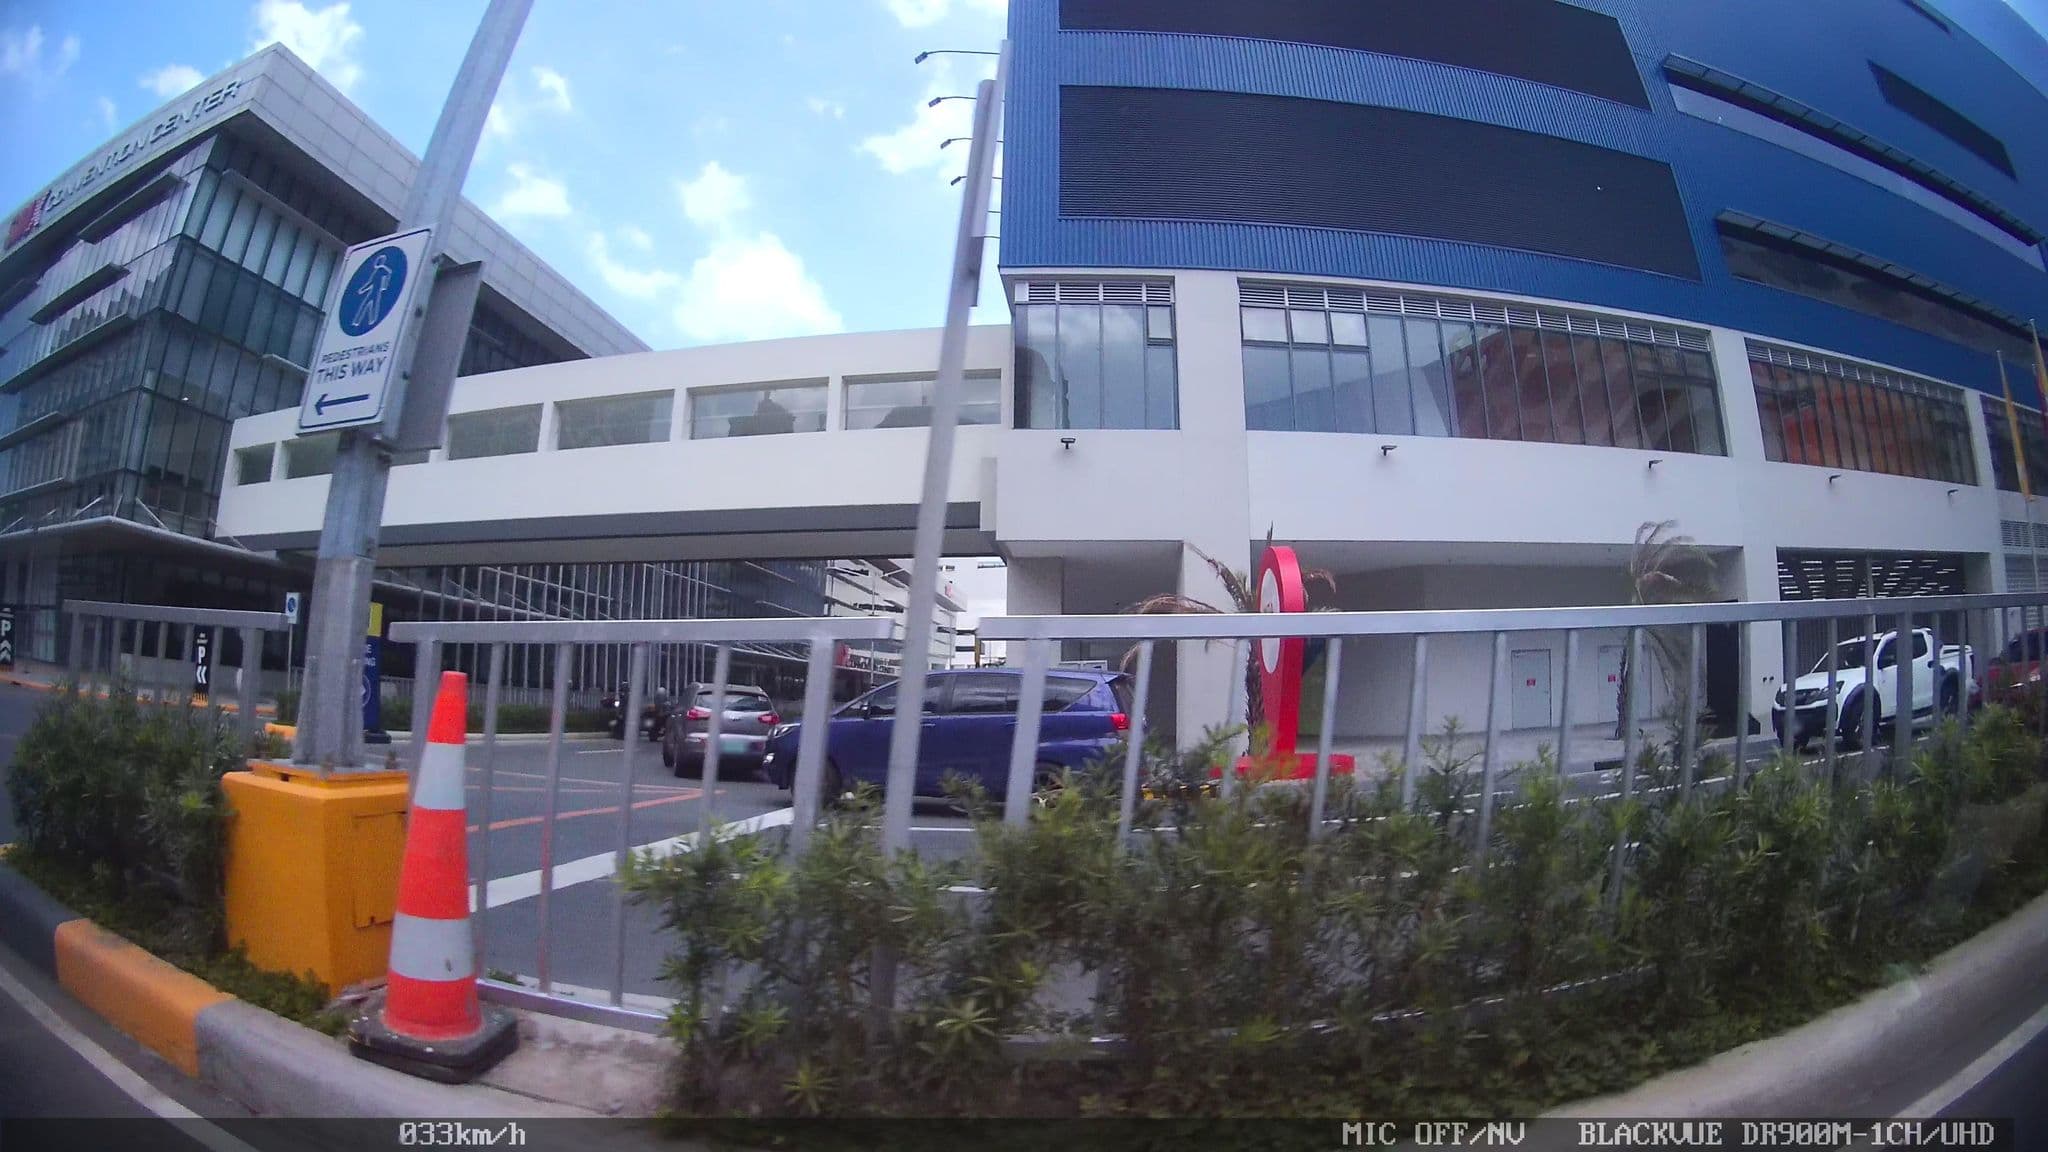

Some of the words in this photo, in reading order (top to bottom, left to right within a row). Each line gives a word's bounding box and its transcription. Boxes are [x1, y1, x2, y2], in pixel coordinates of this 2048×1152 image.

[46, 133, 149, 213] CONVENTION
[150, 78, 244, 144] CENTER
[322, 341, 389, 364] PEDESTRIANS
[317, 364, 348, 384] THIS
[351, 356, 387, 377] WAY
[1, 619, 12, 637] P
[198, 645, 206, 665] P
